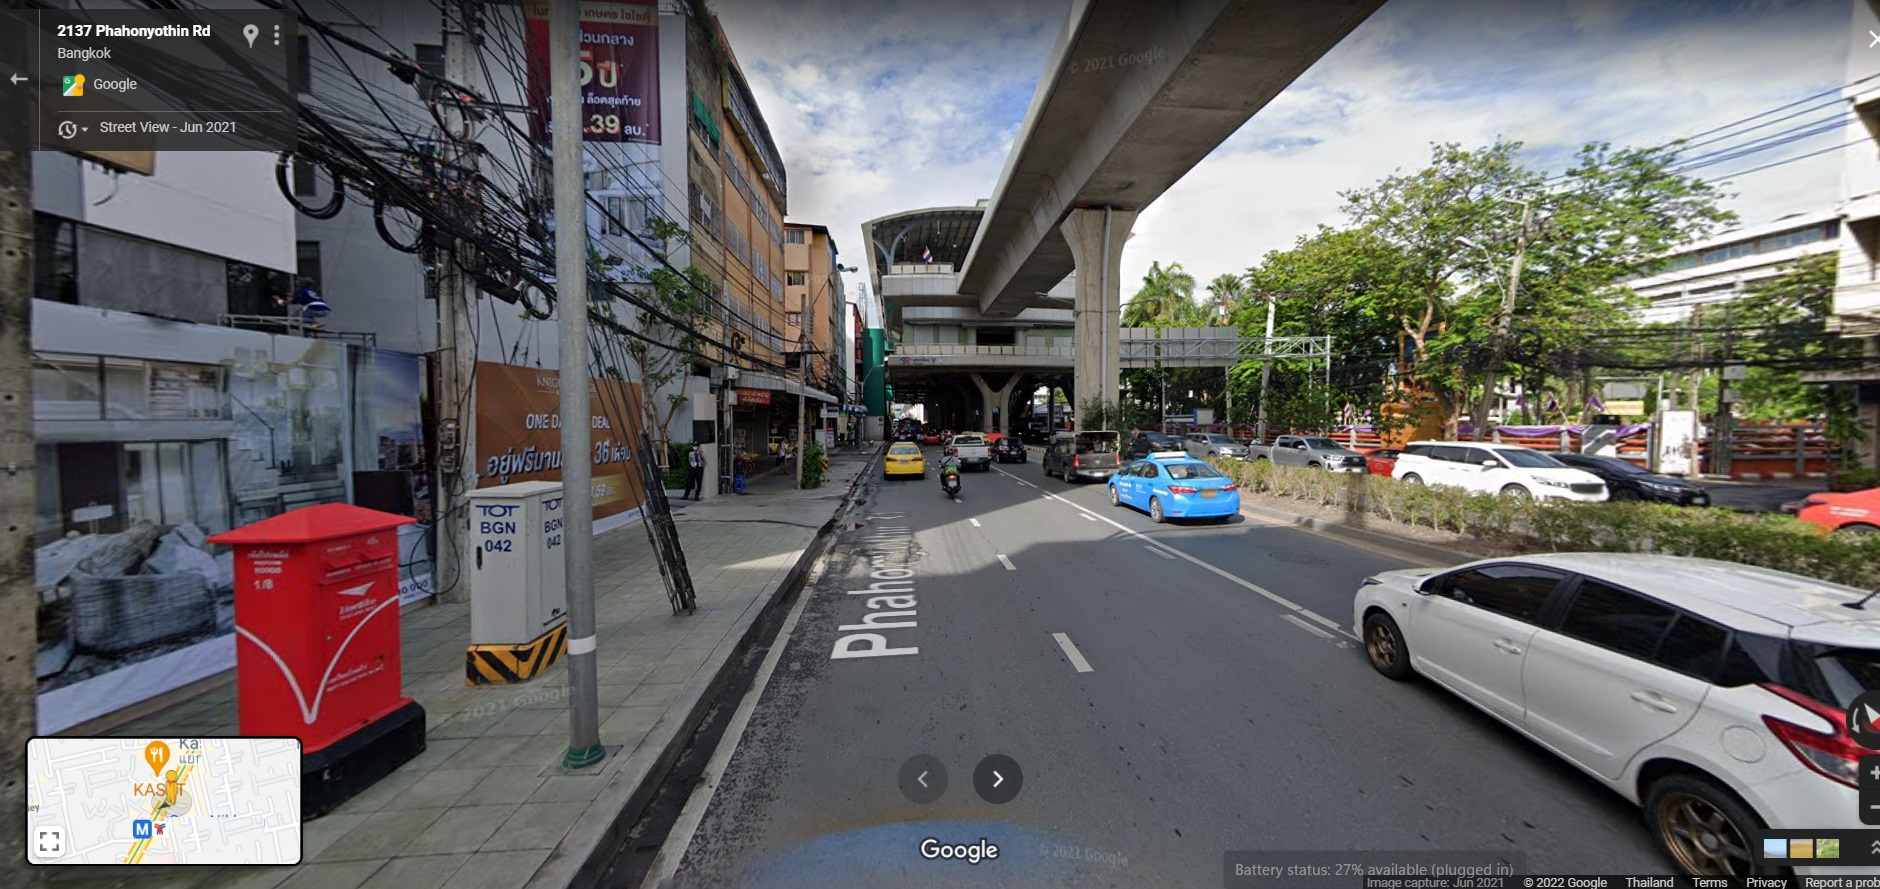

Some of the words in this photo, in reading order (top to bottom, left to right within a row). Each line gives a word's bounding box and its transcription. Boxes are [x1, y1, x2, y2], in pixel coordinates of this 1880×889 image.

[583, 114, 620, 134] .39
[526, 413, 549, 430] ONE
[487, 445, 562, 484] อยู่ฟรีนาน
[594, 440, 610, 464] 36
[475, 504, 520, 517] TOT
[480, 521, 516, 534] BGN
[544, 518, 562, 533] BGN
[485, 540, 512, 552] 042
[546, 534, 561, 549] 042
